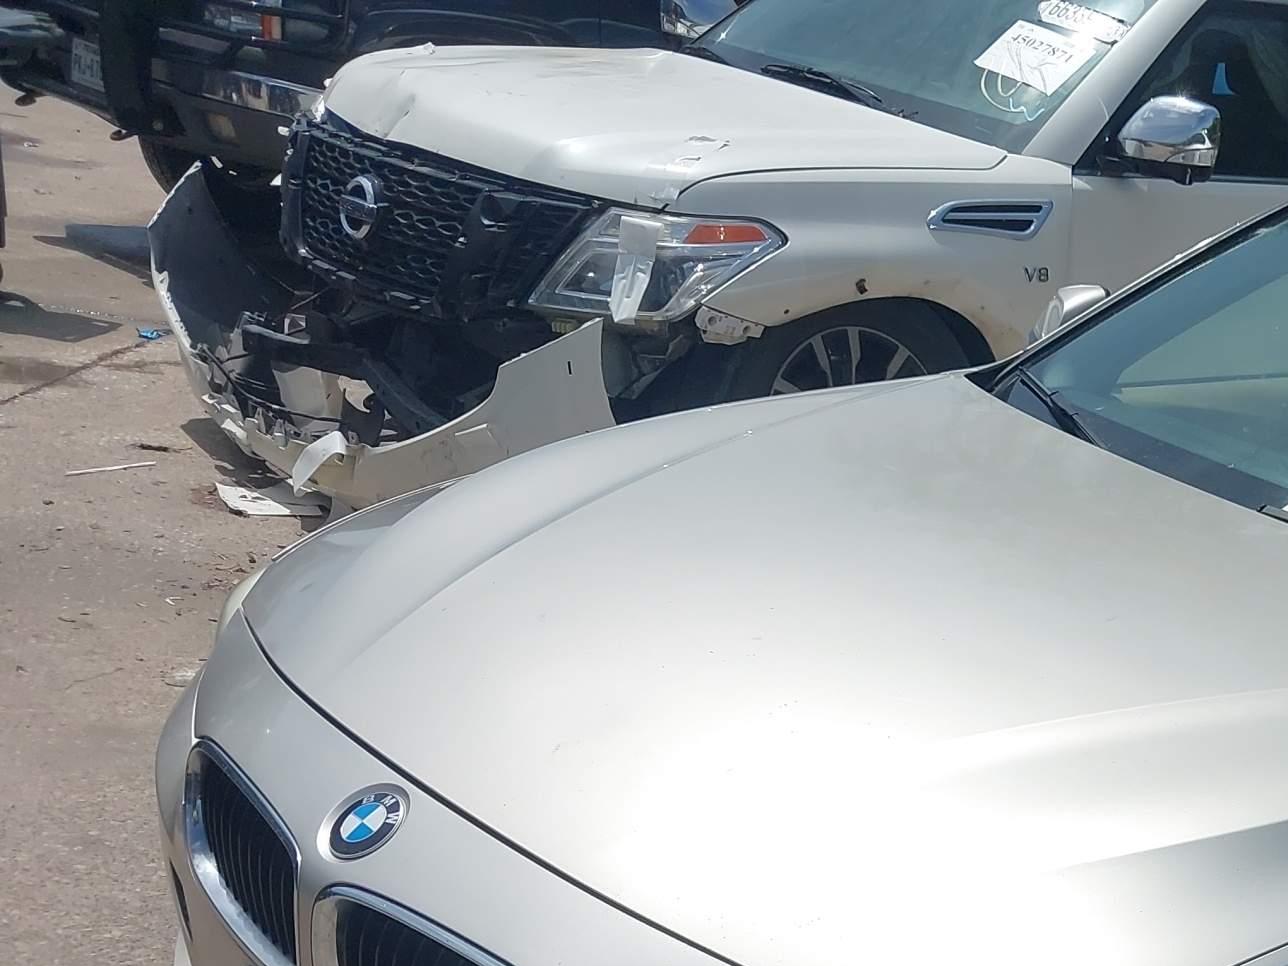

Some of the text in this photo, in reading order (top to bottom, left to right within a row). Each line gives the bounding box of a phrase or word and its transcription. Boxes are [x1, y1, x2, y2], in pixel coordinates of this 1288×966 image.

[1011, 34, 1073, 62] 45027871
[1024, 267, 1049, 282] V8
[362, 795, 401, 824] BMW
